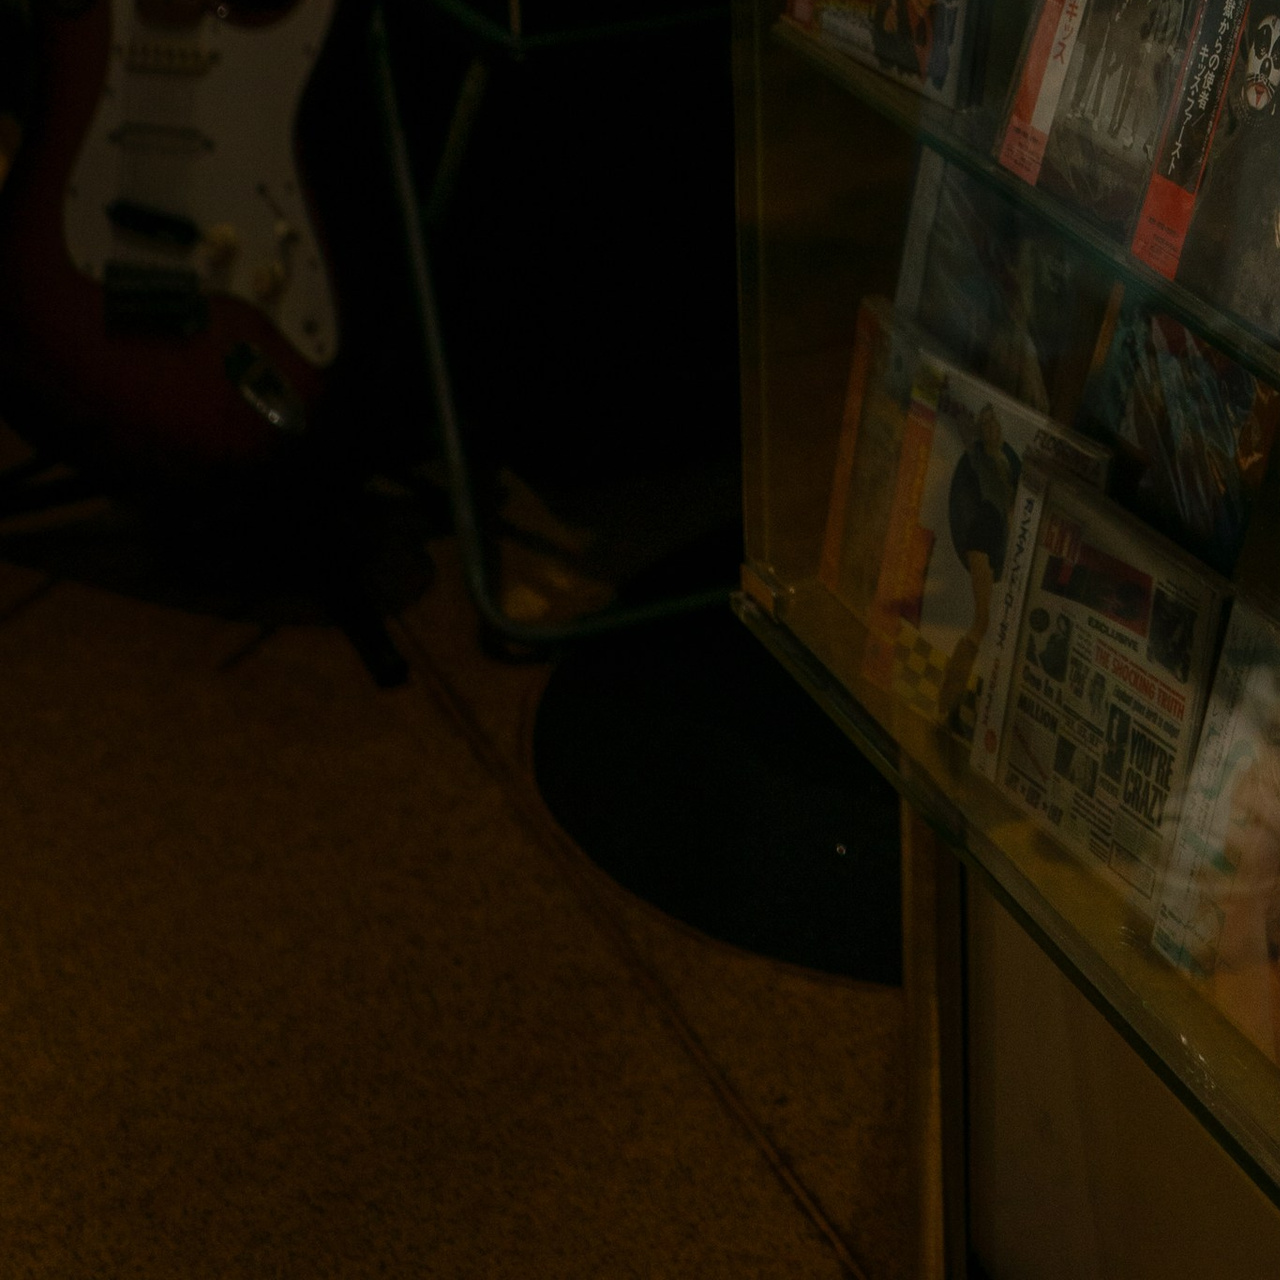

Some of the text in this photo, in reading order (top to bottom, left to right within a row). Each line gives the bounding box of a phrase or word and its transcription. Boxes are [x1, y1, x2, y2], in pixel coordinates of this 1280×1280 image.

[1052, 2, 1080, 66] キッス
[1167, 43, 1210, 176] キッス・ファースト
[1111, 655, 1158, 702] SHOCKING
[1157, 687, 1186, 721] TRUTH
[1129, 723, 1177, 792] YOU'RE
[1122, 767, 1169, 828] CRAZY
